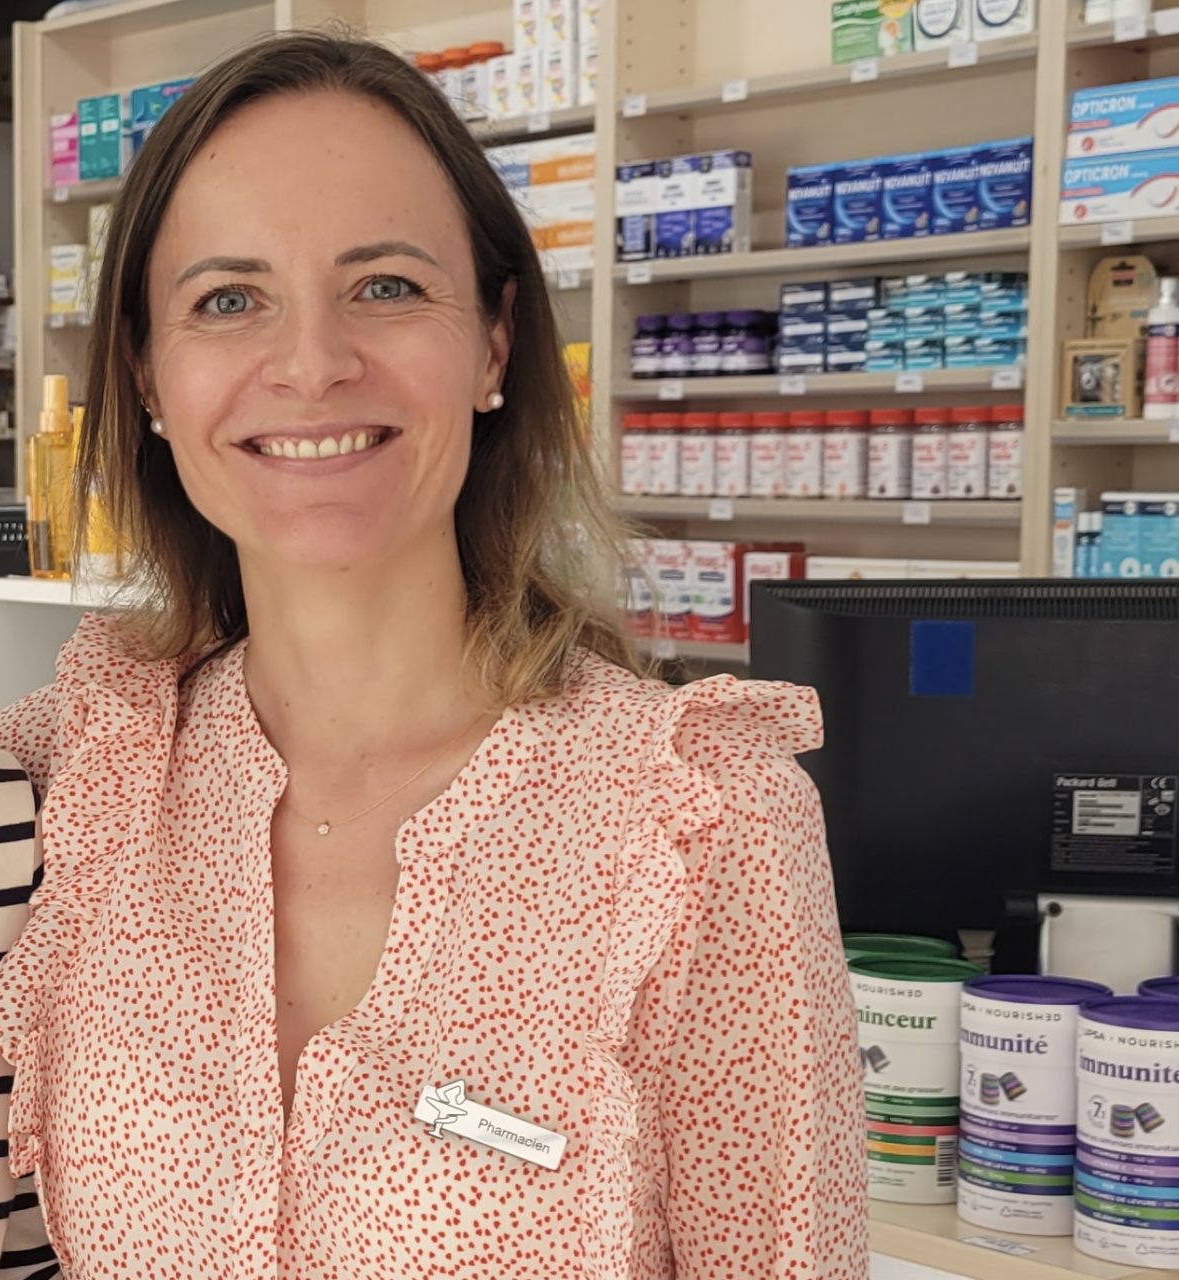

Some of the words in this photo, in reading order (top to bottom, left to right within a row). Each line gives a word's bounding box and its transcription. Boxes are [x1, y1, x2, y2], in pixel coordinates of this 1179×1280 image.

[1072, 95, 1137, 117] OPTICRON
[1064, 163, 1131, 184] OPTICRON
[1056, 776, 1096, 788] Packard
[1097, 777, 1117, 788] Bell
[960, 1028, 1049, 1054] mmunité
[478, 1118, 551, 1155] Pharmacien
